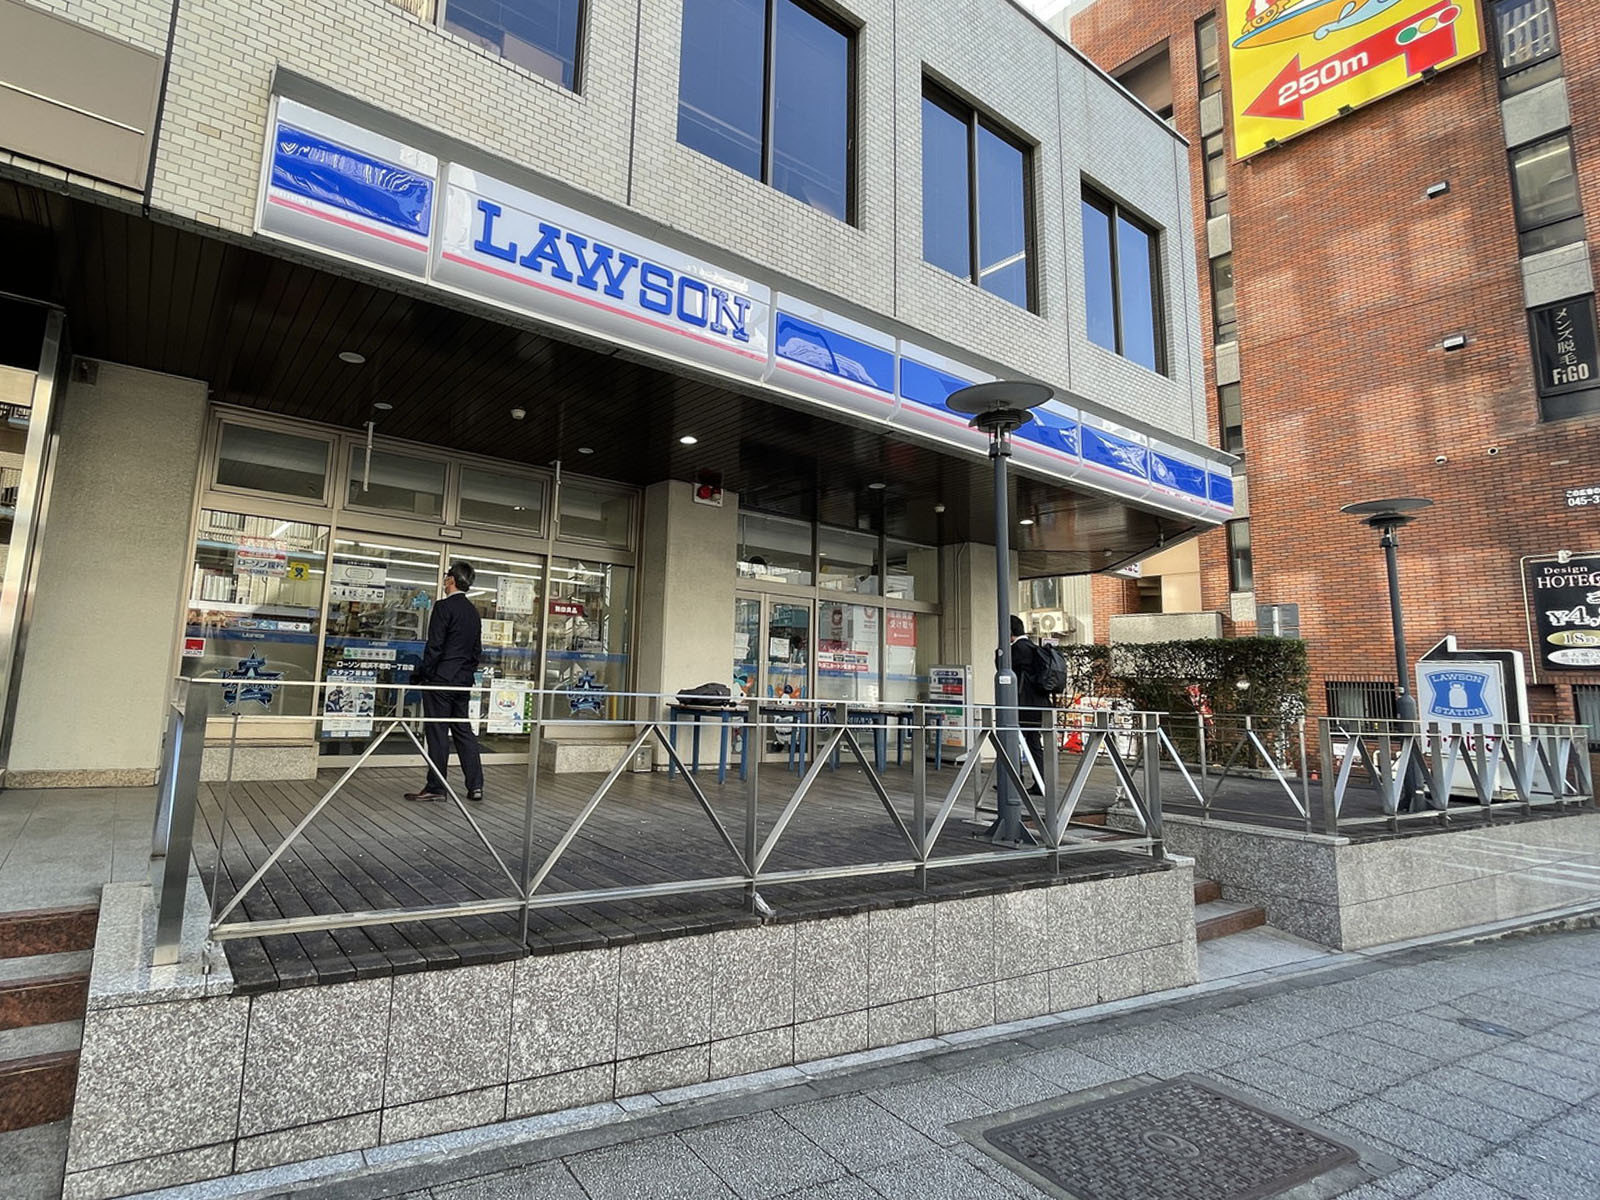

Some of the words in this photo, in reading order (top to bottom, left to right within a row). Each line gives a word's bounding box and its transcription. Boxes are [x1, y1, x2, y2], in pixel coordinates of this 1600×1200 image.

[1277, 51, 1369, 106] 250m
[474, 199, 751, 343] LAWSON
[1555, 307, 1578, 365] メンズ脱毛
[1552, 363, 1590, 385] FiGO
[1568, 494, 1600, 507] 045-3
[1543, 566, 1588, 575] Design
[482, 666, 495, 675] 24
[1430, 673, 1483, 684] LAWSON
[1433, 705, 1486, 717] STATION
